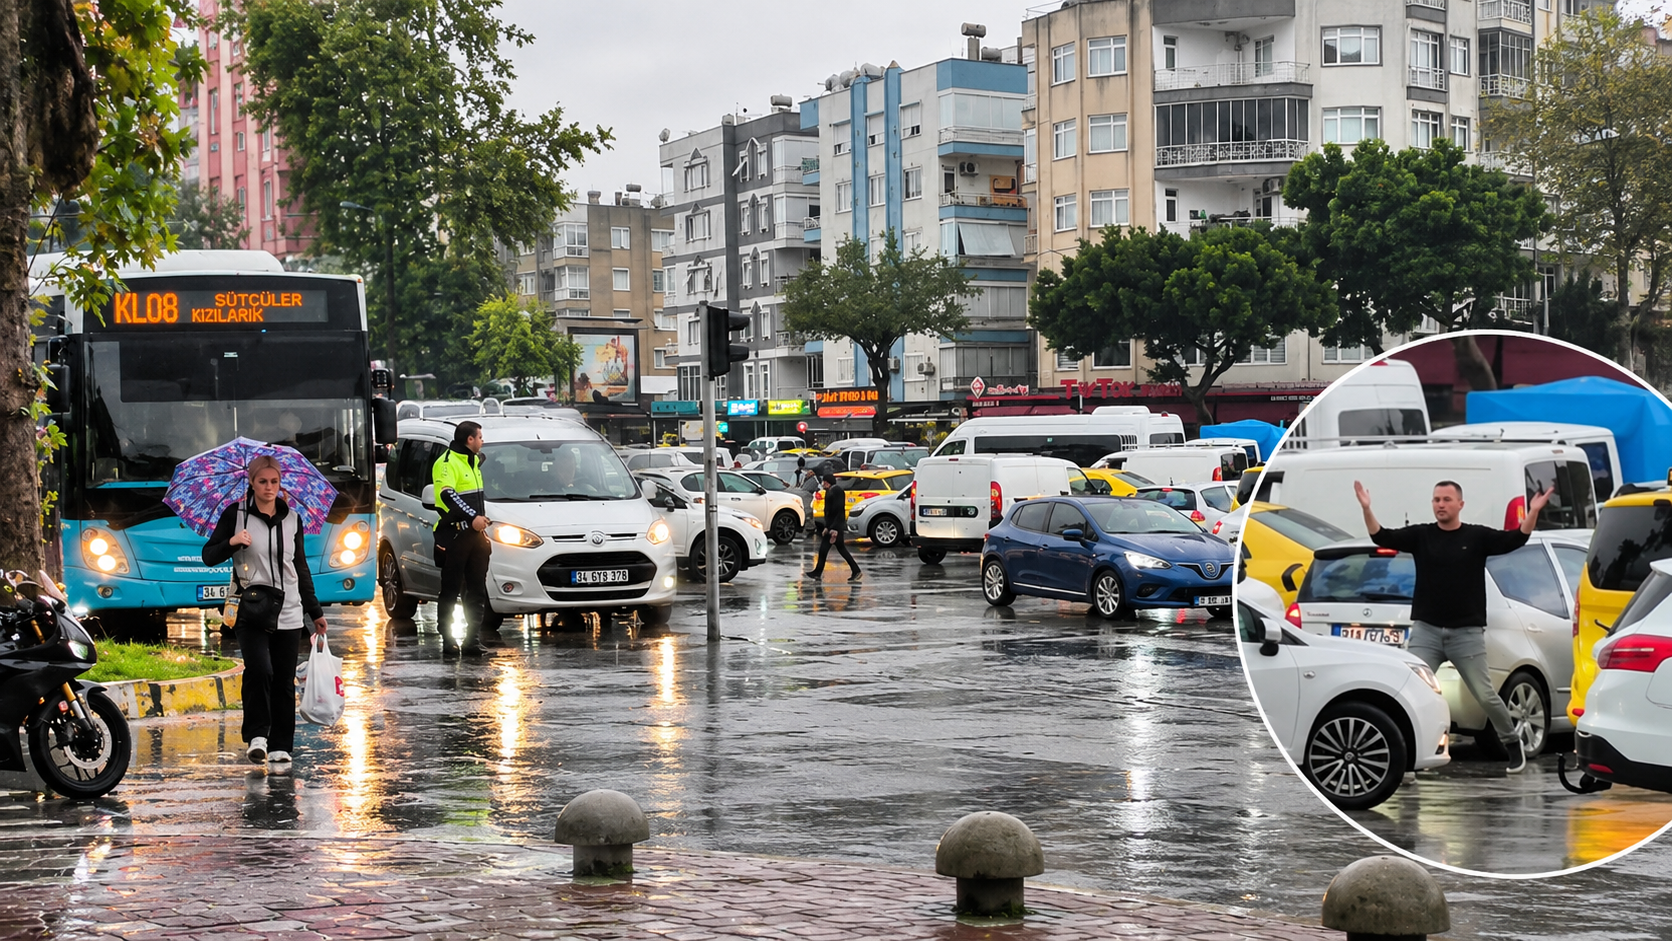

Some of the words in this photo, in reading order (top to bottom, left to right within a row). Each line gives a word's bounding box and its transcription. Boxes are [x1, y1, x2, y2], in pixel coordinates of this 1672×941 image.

[215, 291, 302, 308] SÜTÇÜLER
[114, 292, 179, 324] KL08
[191, 307, 264, 323] KIZILARIK
[577, 572, 587, 582] 34
